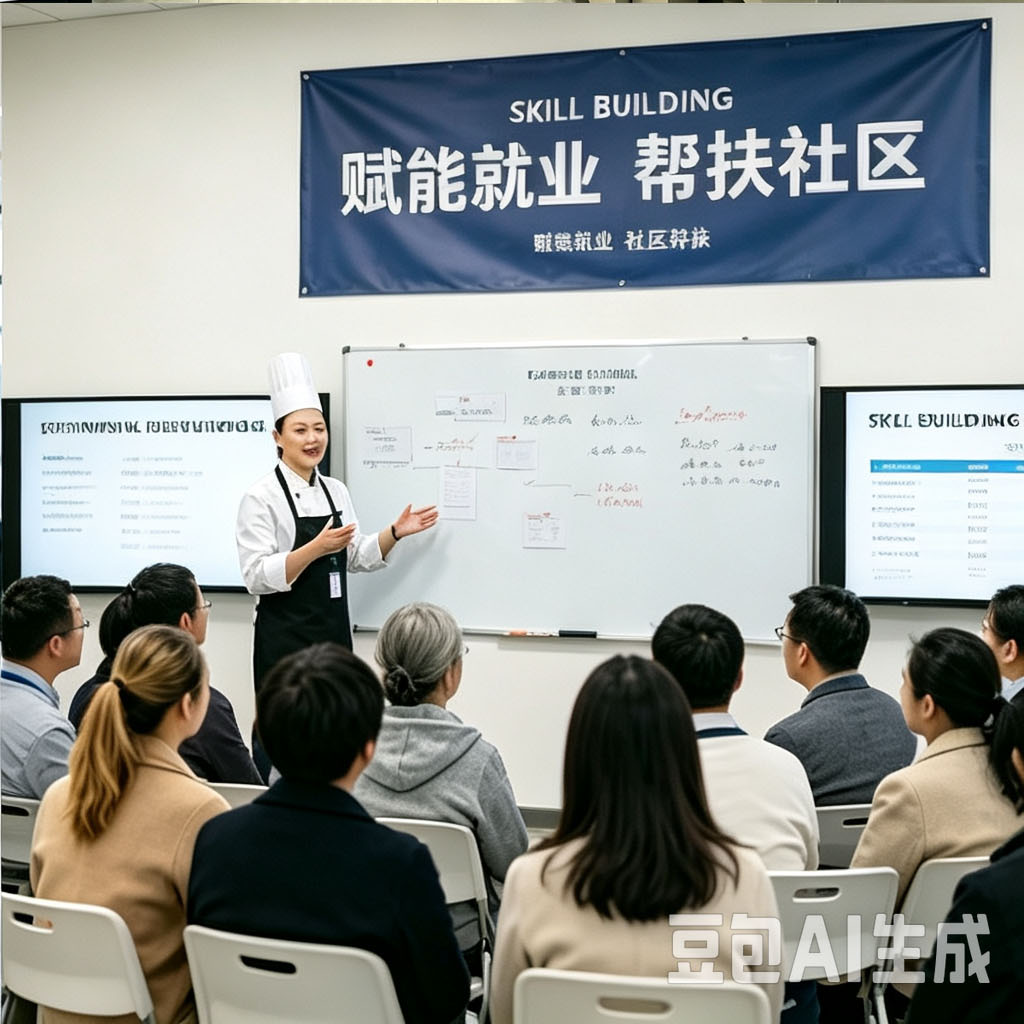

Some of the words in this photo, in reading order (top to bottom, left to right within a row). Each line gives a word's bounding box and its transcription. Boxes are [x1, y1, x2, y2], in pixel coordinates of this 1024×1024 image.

[509, 95, 584, 124] SKILL
[593, 86, 733, 119] BUILDING
[340, 140, 601, 216] 赋能就业
[633, 119, 926, 204] 帮扶社区
